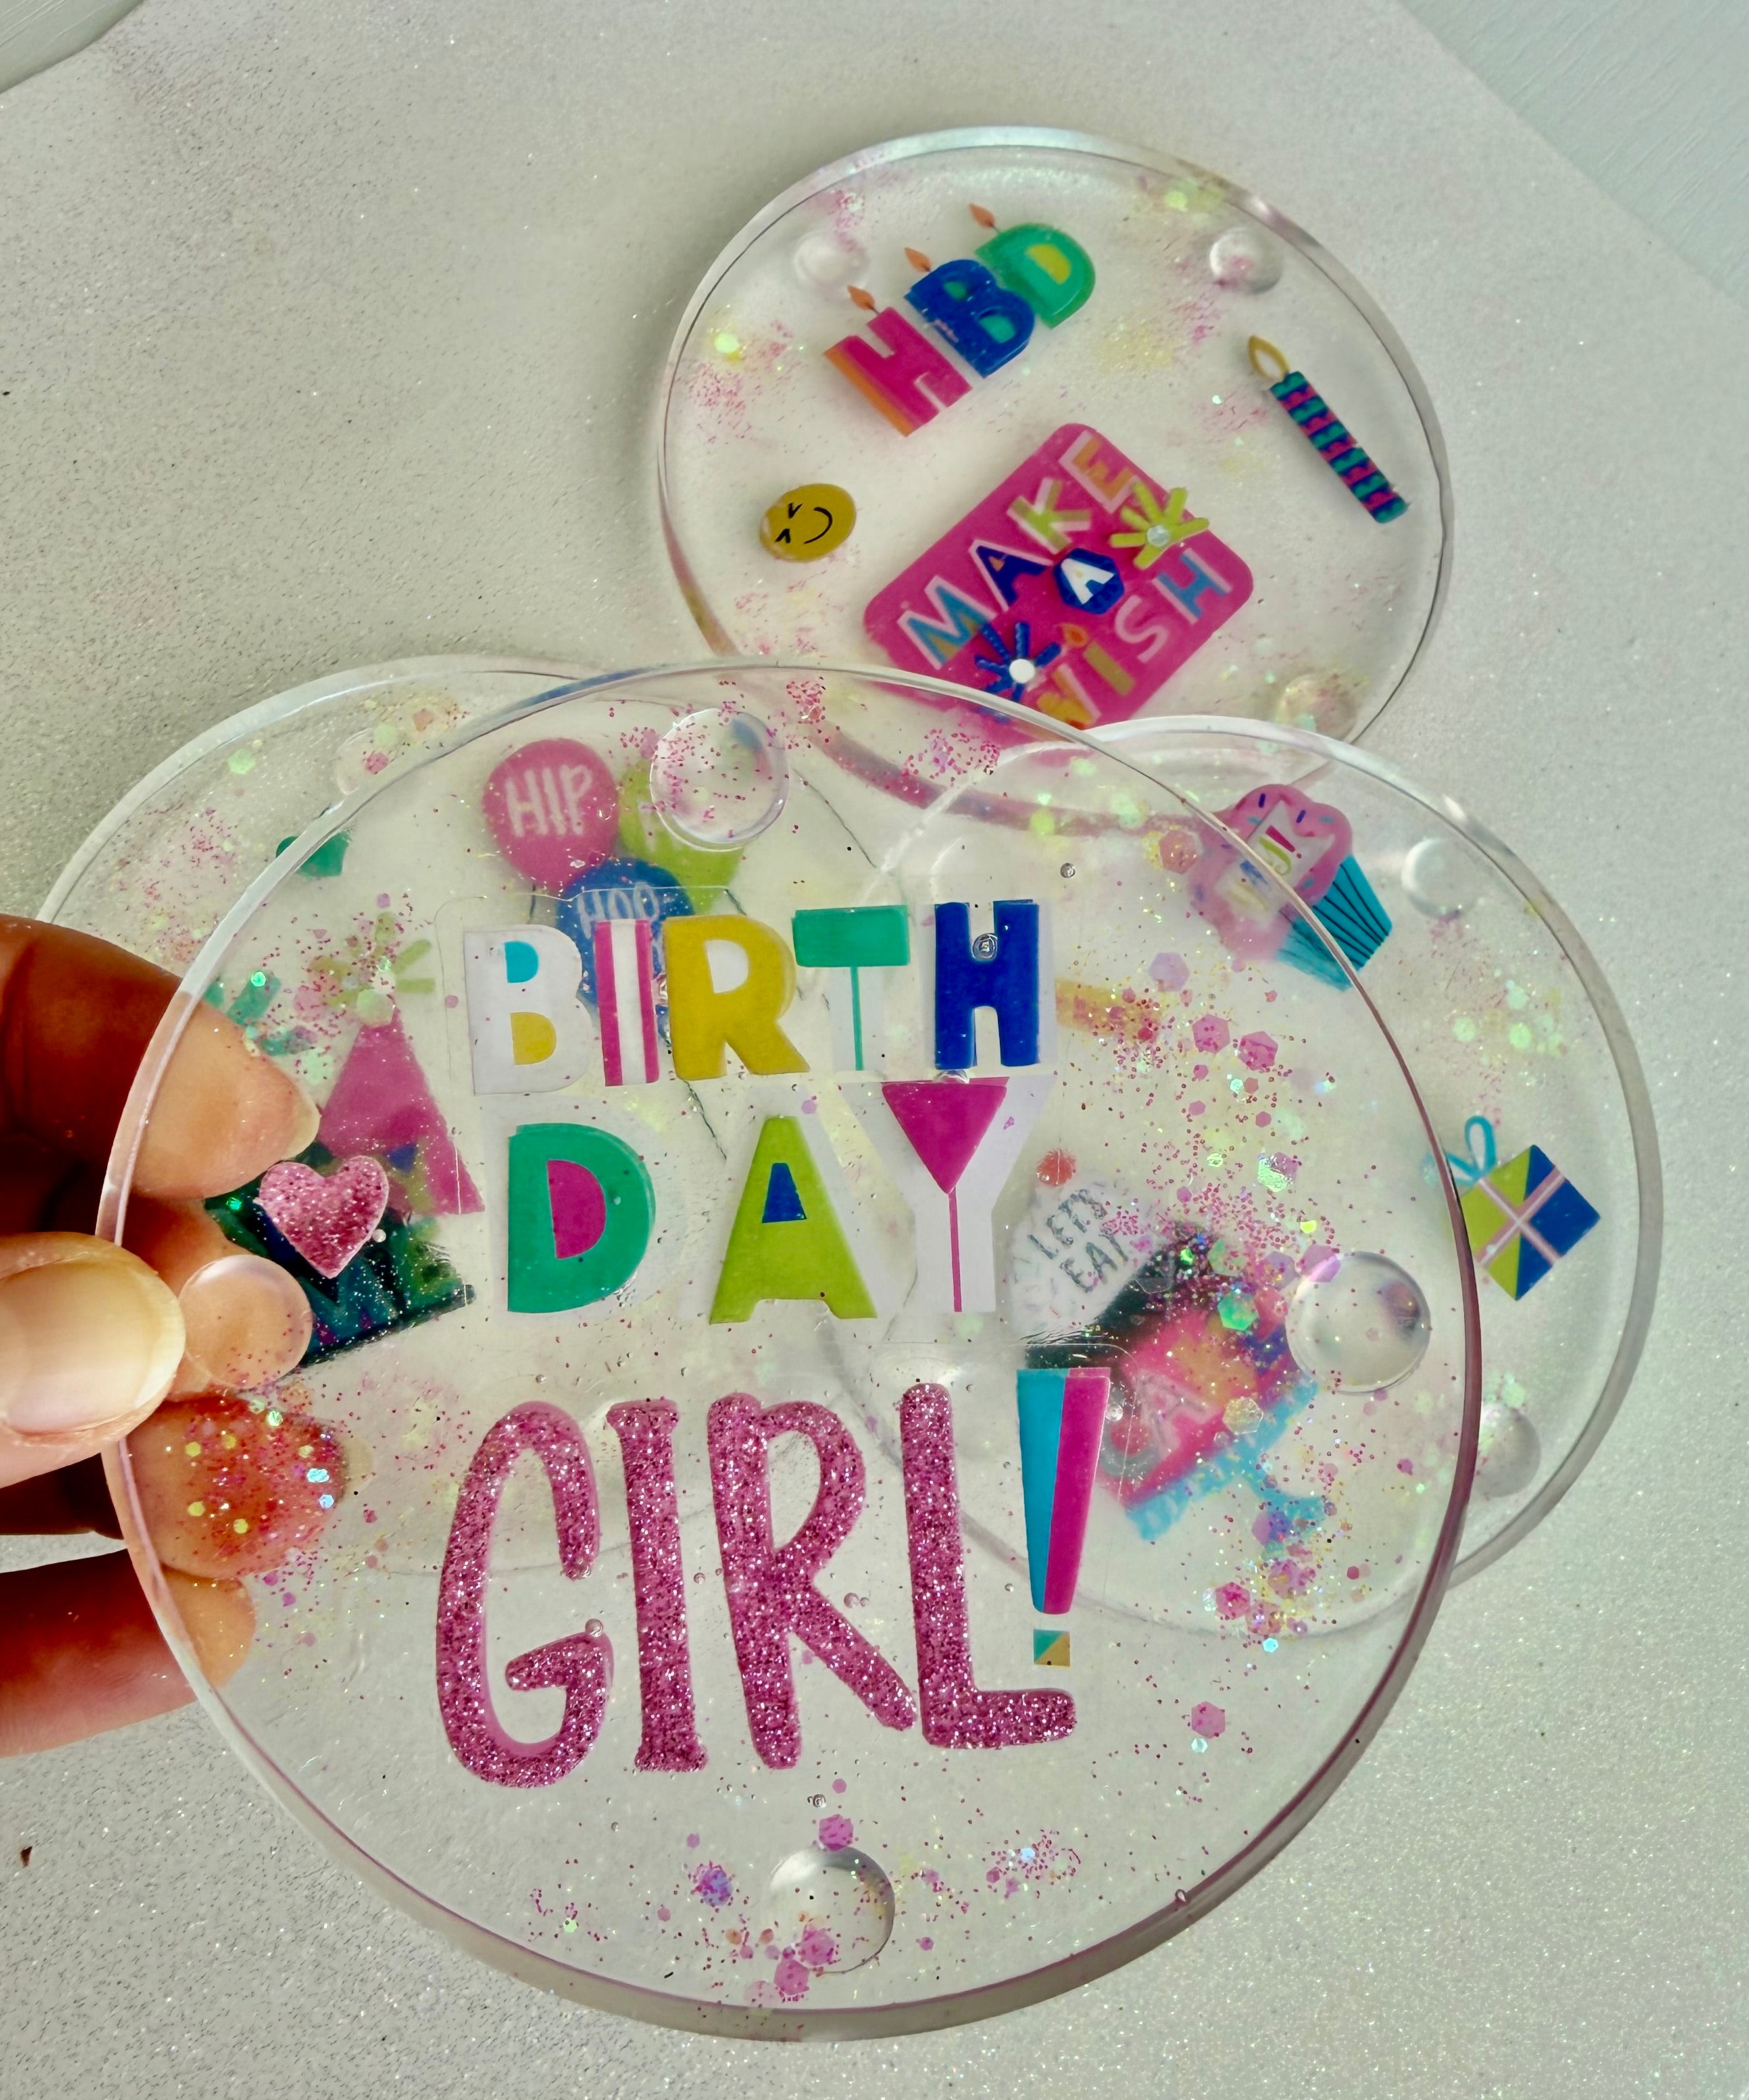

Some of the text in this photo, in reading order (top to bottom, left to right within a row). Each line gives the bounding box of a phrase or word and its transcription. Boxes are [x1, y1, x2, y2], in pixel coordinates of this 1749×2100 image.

[824, 222, 1096, 437] HBD
[897, 429, 1139, 670] MAKE
[1060, 556, 1116, 605] A
[504, 763, 592, 838] HIP
[463, 899, 1041, 1096] BIRTH
[507, 1077, 1045, 1324] DAY
[1058, 1232, 1129, 1293] EAT
[436, 1366, 1112, 1788] GIRL!
